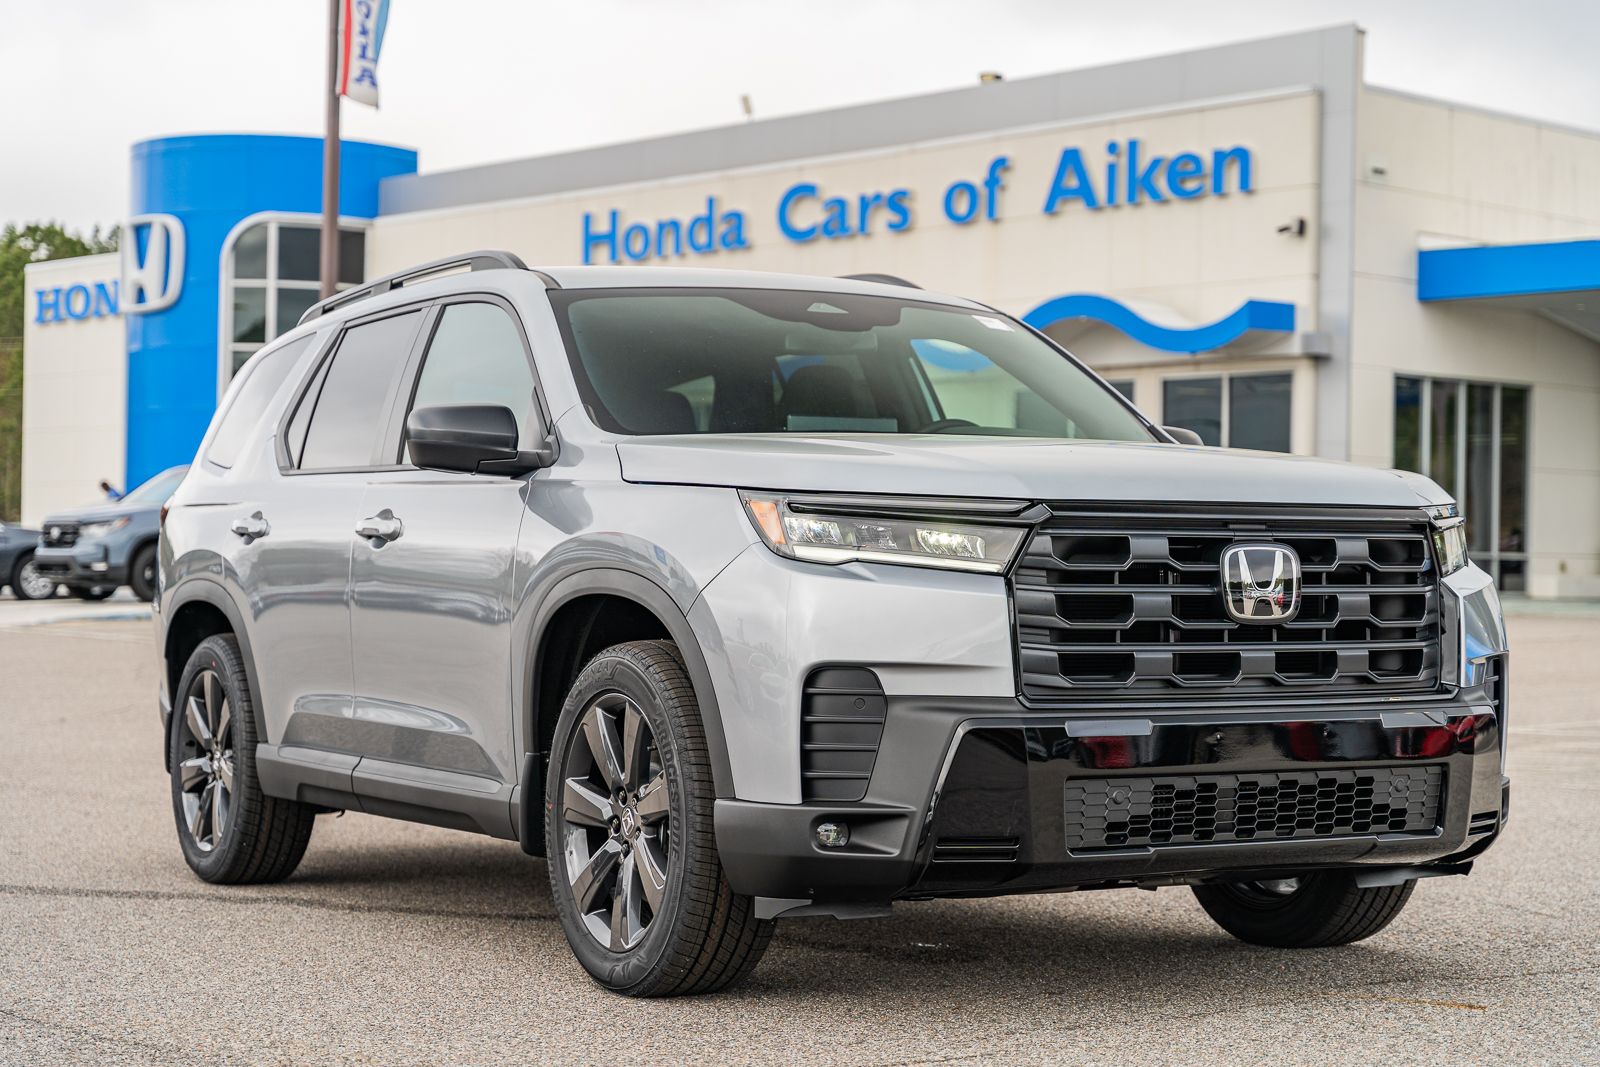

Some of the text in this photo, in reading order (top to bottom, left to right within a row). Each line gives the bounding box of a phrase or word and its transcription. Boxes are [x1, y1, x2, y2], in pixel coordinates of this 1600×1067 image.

[582, 139, 1253, 266] Honda Cars of Aiken
